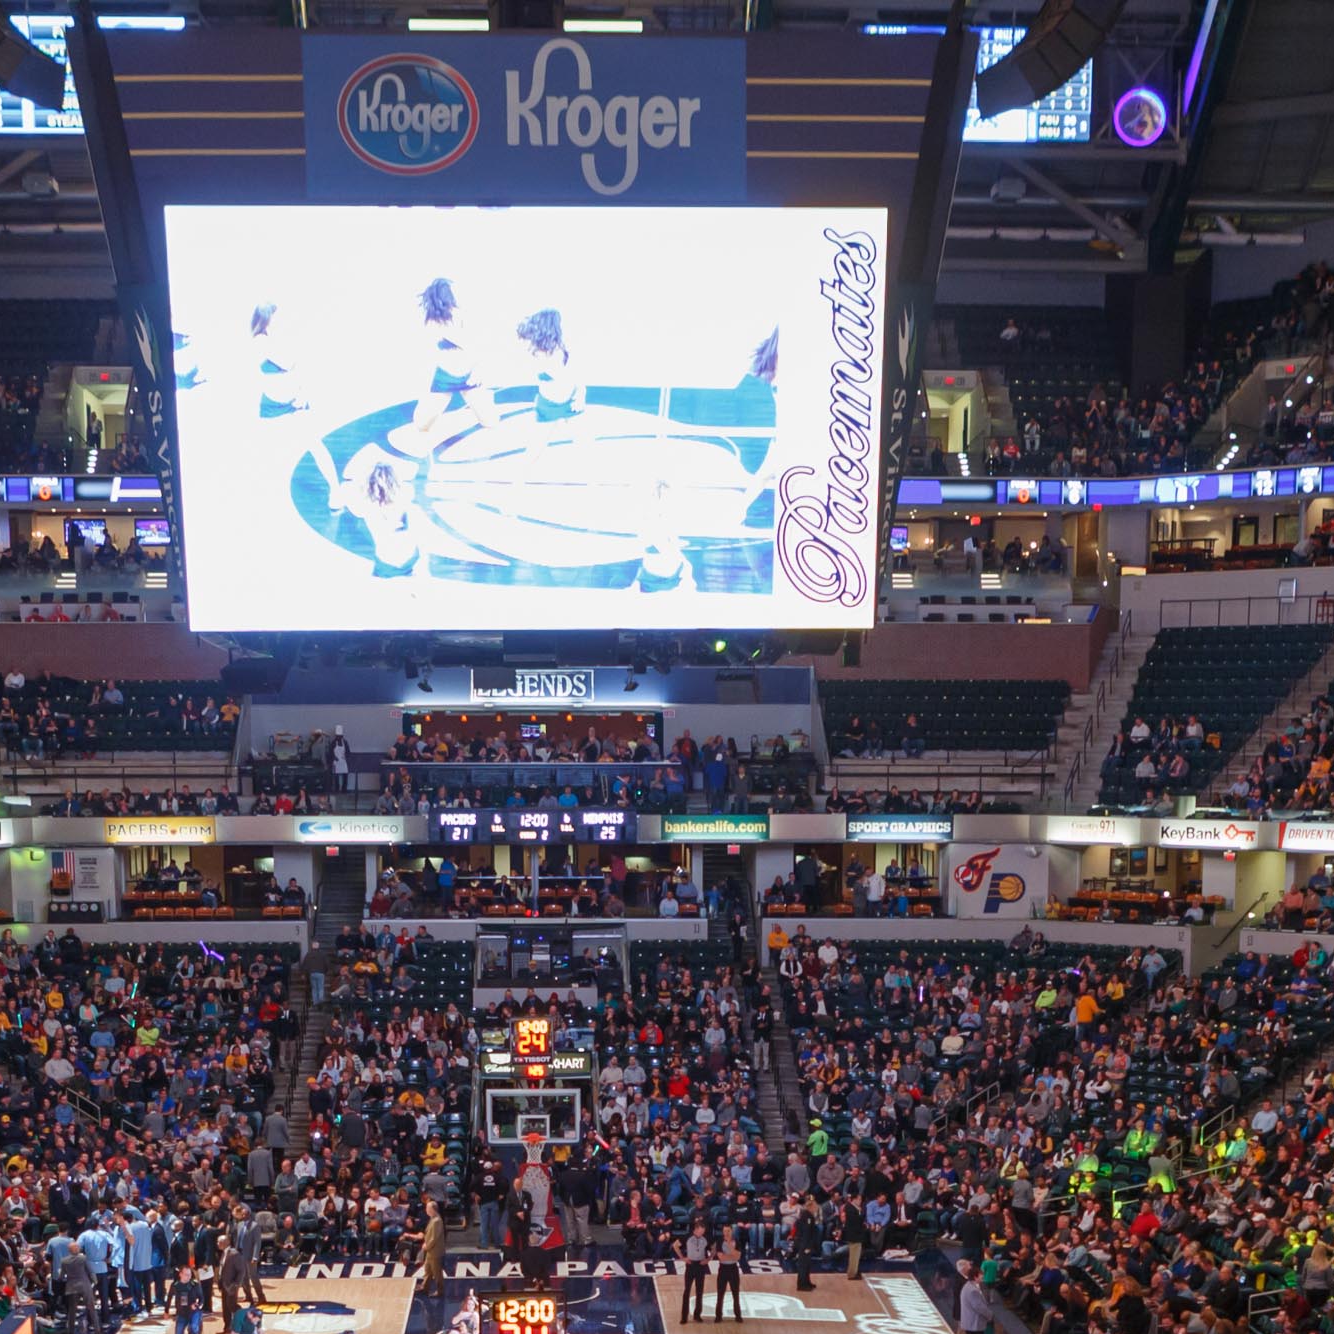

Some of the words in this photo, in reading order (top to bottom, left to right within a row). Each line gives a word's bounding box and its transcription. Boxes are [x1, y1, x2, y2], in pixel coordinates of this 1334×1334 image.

[358, 72, 464, 159] Kroger
[505, 38, 701, 196] Kroger
[776, 227, 878, 609] Pacemates
[1255, 480, 1273, 496] 12
[1303, 477, 1314, 493] 3
[476, 673, 587, 697] GENDS
[338, 820, 399, 834] Kinetico
[440, 813, 477, 826] PACERS
[520, 813, 549, 828] 12:00
[583, 812, 624, 825] MEMPHIS
[664, 820, 767, 833] bankerslife.com
[848, 820, 888, 833] SPORT
[890, 820, 952, 833] GRAPHICS
[600, 826, 616, 841] 25
[1161, 826, 1221, 842] KeyBank
[1288, 828, 1327, 840] DRIVEN
[518, 1020, 548, 1034] 12:00
[518, 1034, 546, 1054] 24
[523, 1055, 551, 1064] TISSOT
[498, 1299, 555, 1323] 12:00
